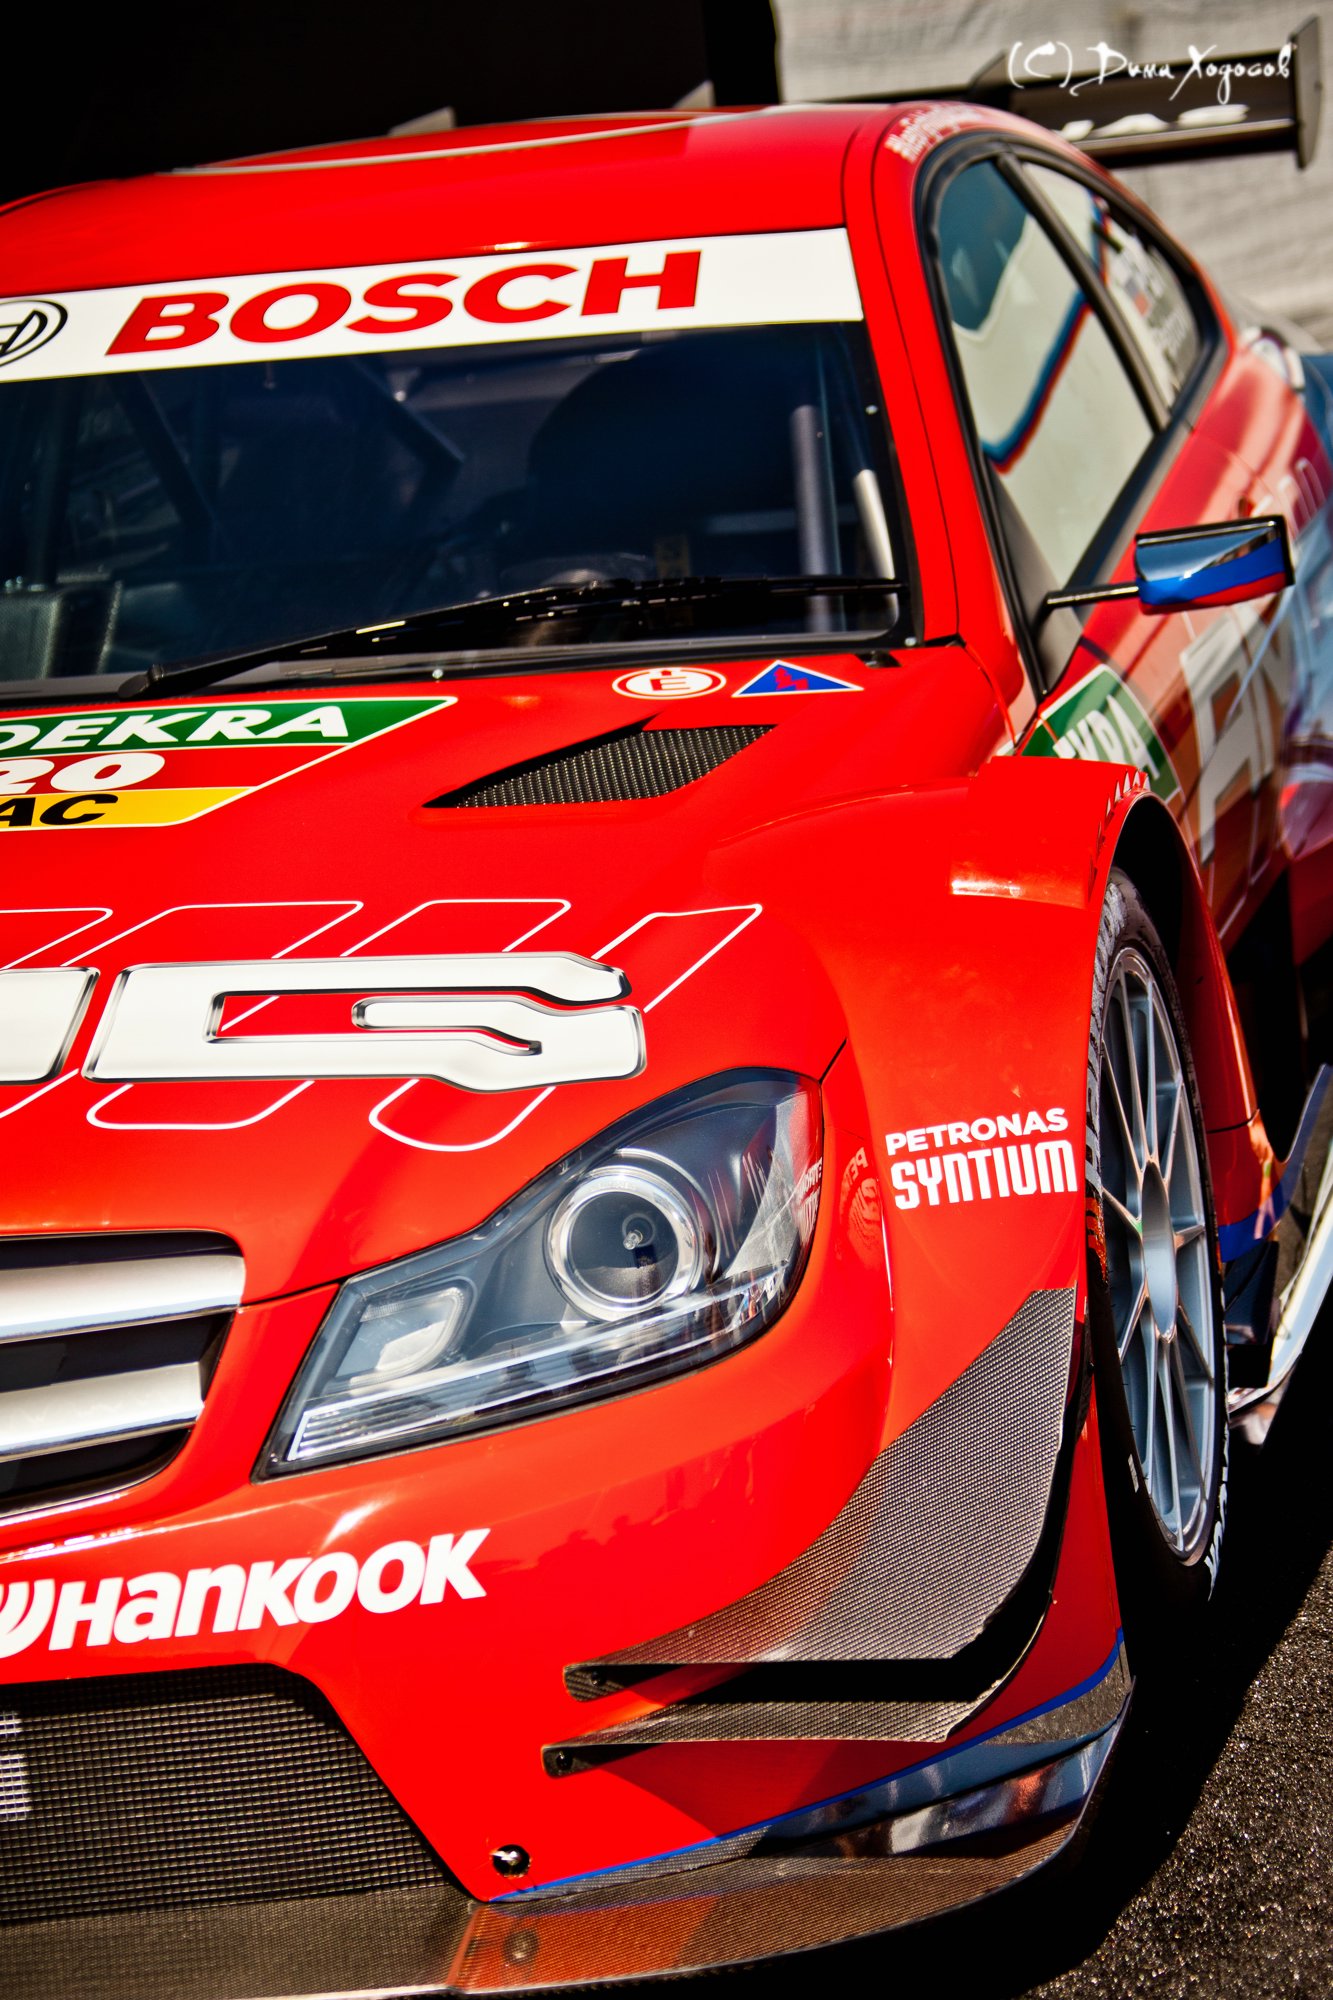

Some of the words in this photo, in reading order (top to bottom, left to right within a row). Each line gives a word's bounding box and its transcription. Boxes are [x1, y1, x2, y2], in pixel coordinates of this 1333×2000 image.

[105, 251, 702, 356] BOSCH
[885, 1107, 1069, 1156] PETRONAS
[889, 1139, 1079, 1210] SYNTIUM
